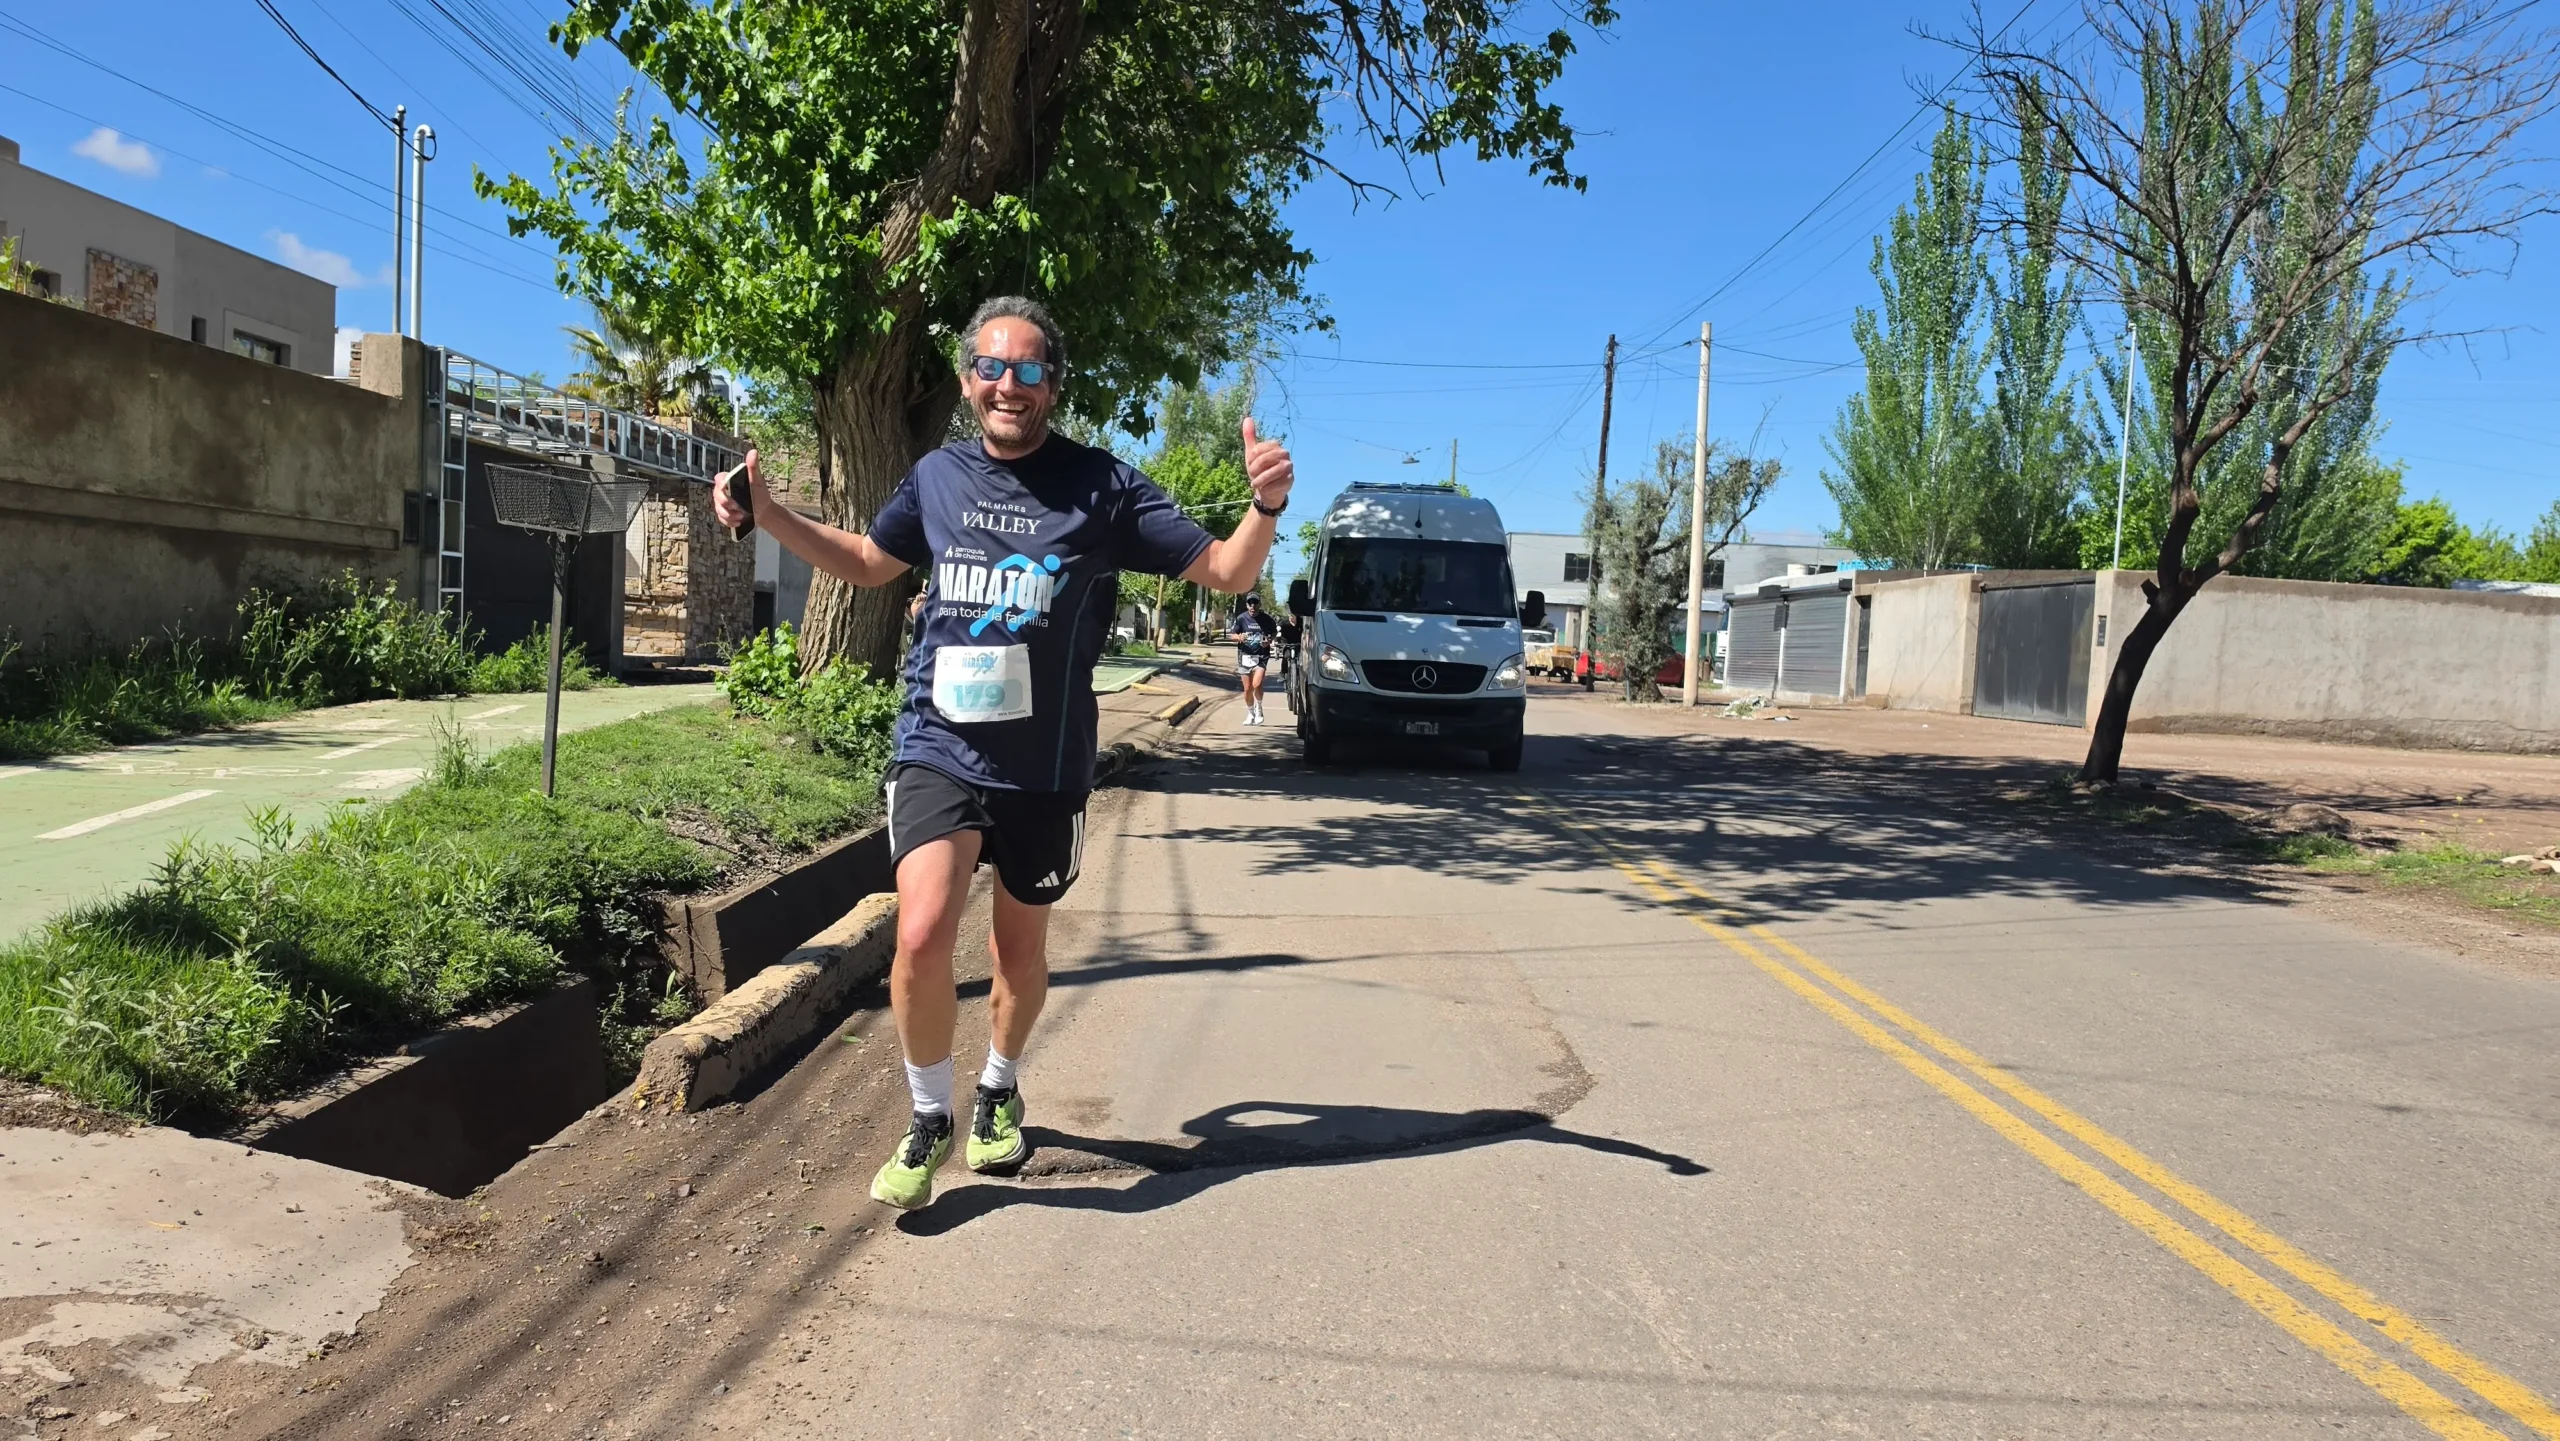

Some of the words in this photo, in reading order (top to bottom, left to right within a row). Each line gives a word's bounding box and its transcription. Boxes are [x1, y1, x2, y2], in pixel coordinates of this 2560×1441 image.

[977, 501, 1026, 513] PALMARES
[962, 511, 1042, 535] VALLEY
[955, 547, 985, 556] parroquia
[962, 553, 988, 562] chacras
[939, 563, 1055, 613] MARATÓN
[938, 606, 957, 618] para
[959, 606, 988, 619] toda
[992, 609, 1002, 621] la
[1005, 611, 1049, 628] familia
[953, 684, 1006, 708] 179
